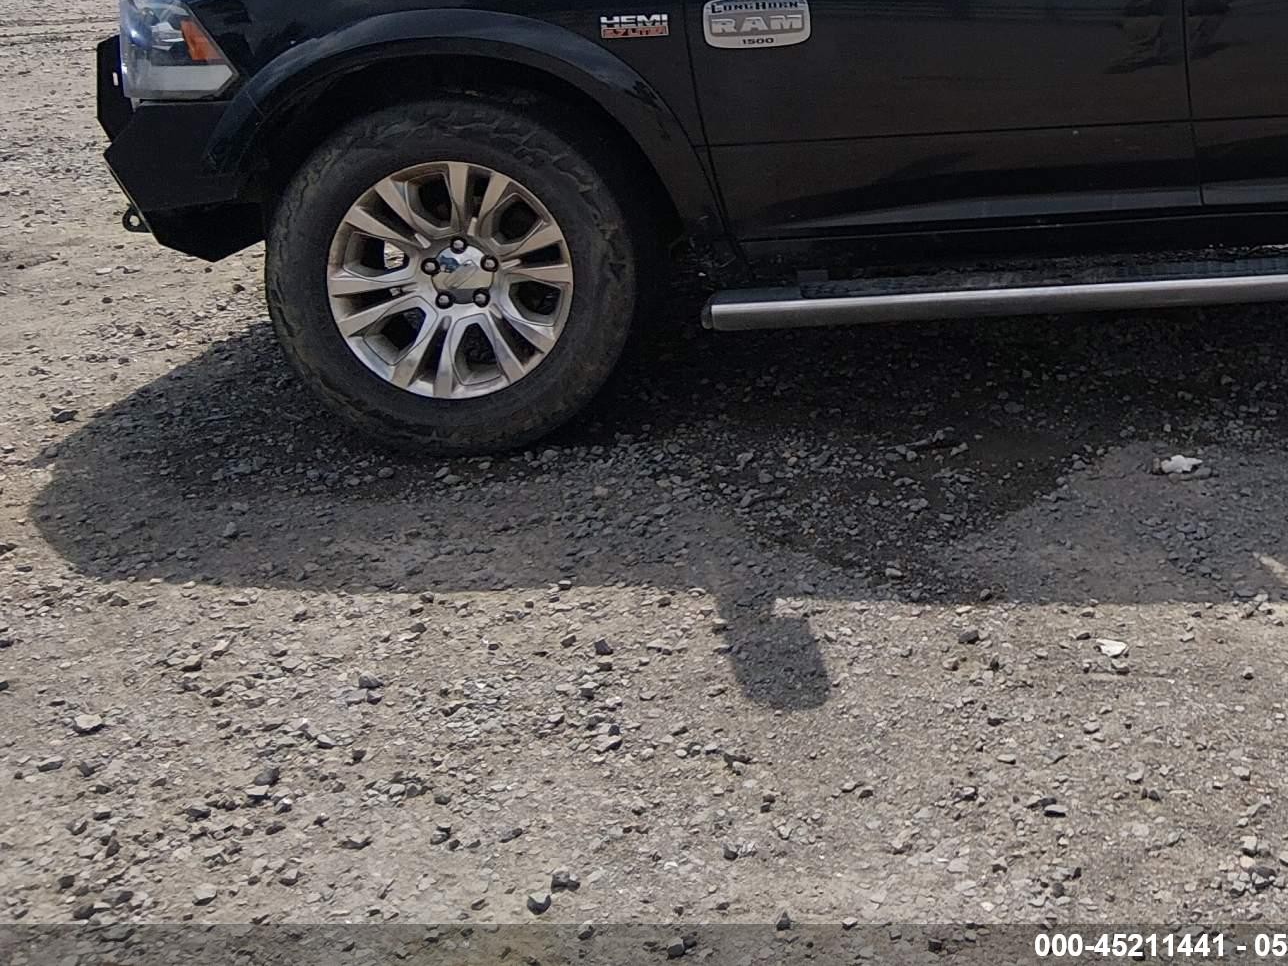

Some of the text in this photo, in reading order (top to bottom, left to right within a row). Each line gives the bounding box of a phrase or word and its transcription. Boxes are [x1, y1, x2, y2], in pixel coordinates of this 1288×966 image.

[600, 14, 668, 28] HEMI
[711, 14, 802, 33] RAM
[742, 37, 775, 45] 1500
